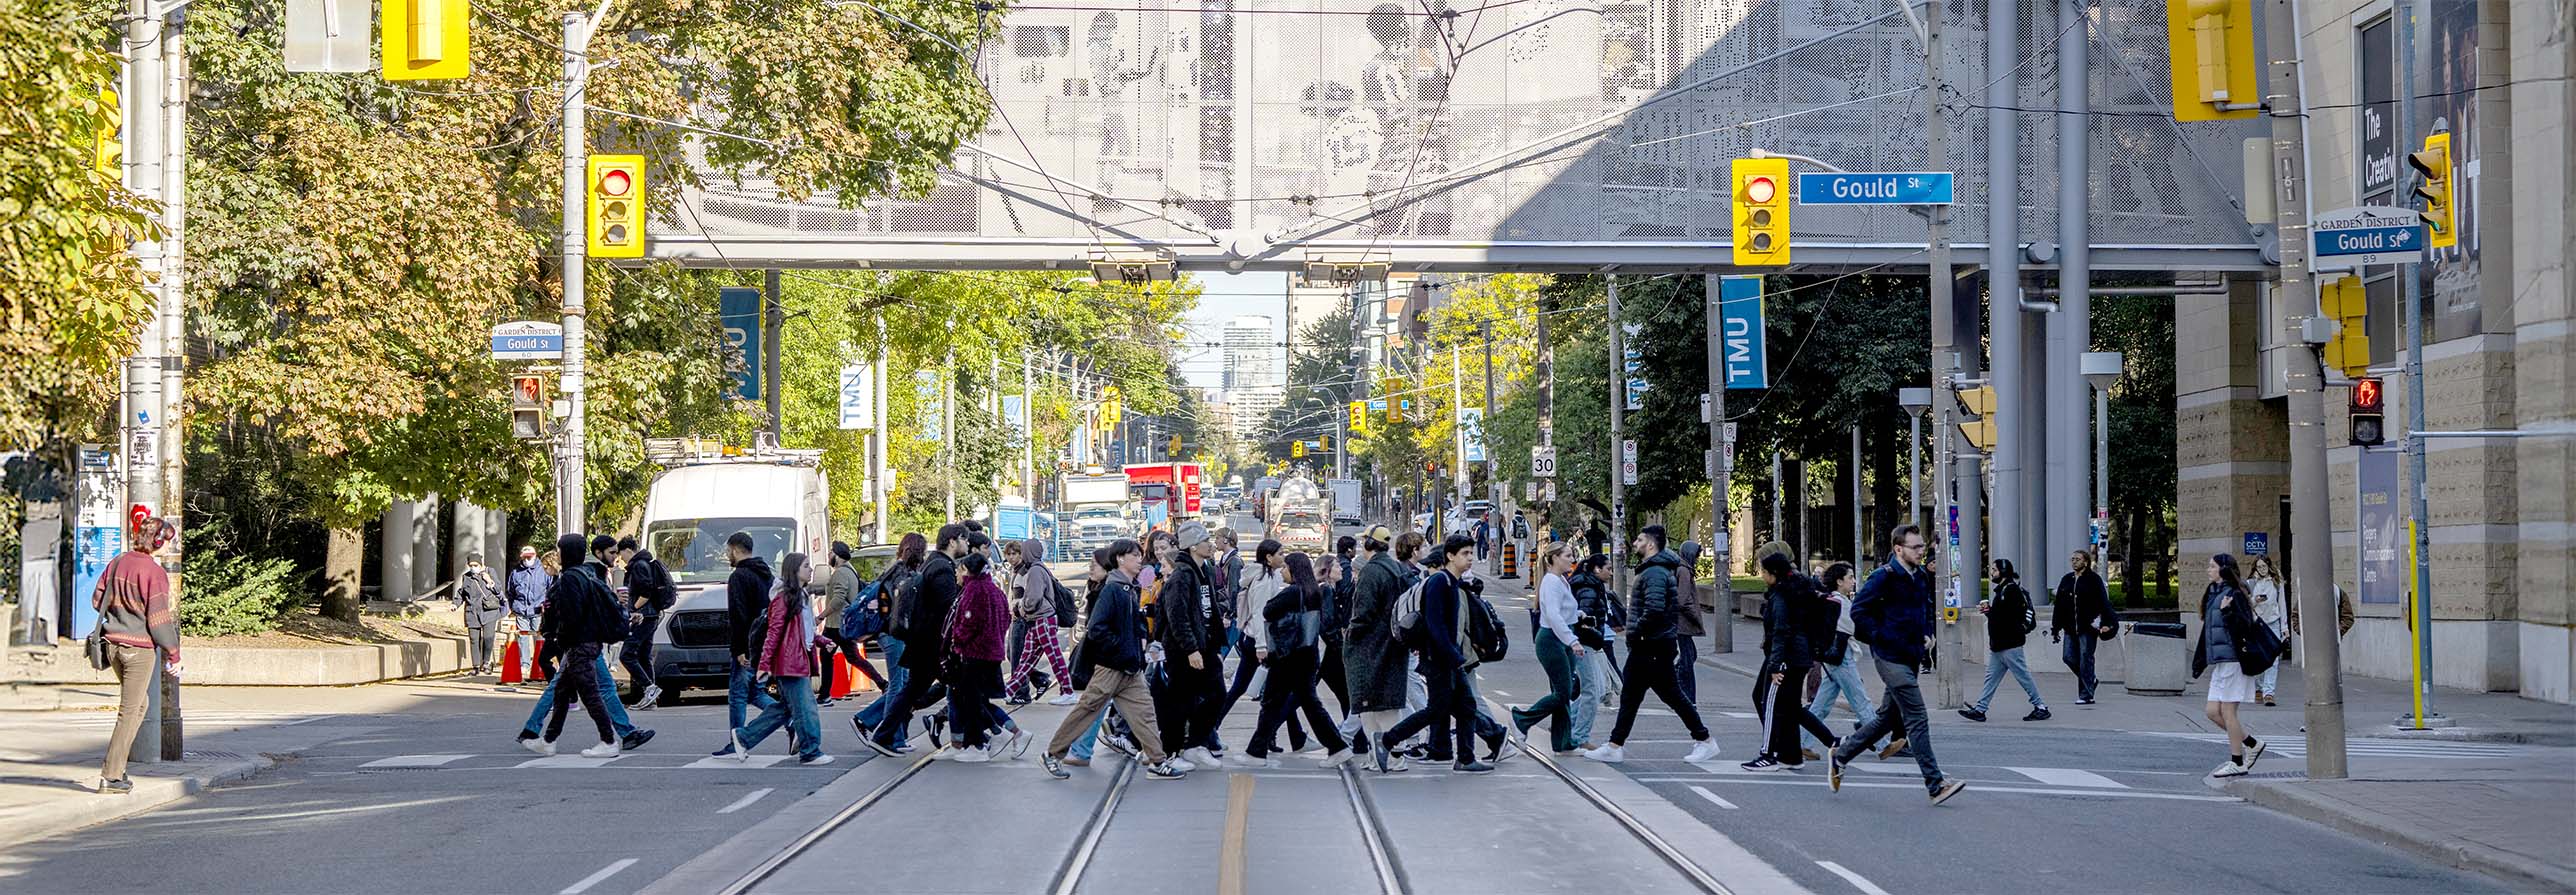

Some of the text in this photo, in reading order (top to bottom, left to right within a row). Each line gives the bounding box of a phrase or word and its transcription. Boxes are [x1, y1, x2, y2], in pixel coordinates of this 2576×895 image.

[2365, 108, 2380, 141] The
[1833, 177, 1920, 198] Gould St
[2321, 216, 2410, 230] GARDEN DISTRICT
[2338, 232, 2383, 250] Gould
[2362, 254, 2377, 264] 89
[498, 328, 526, 336] GARDEN
[507, 338, 549, 349] Gould St
[1726, 317, 1751, 383] TMU
[843, 373, 861, 423] TMU
[1534, 458, 1554, 472] 30
